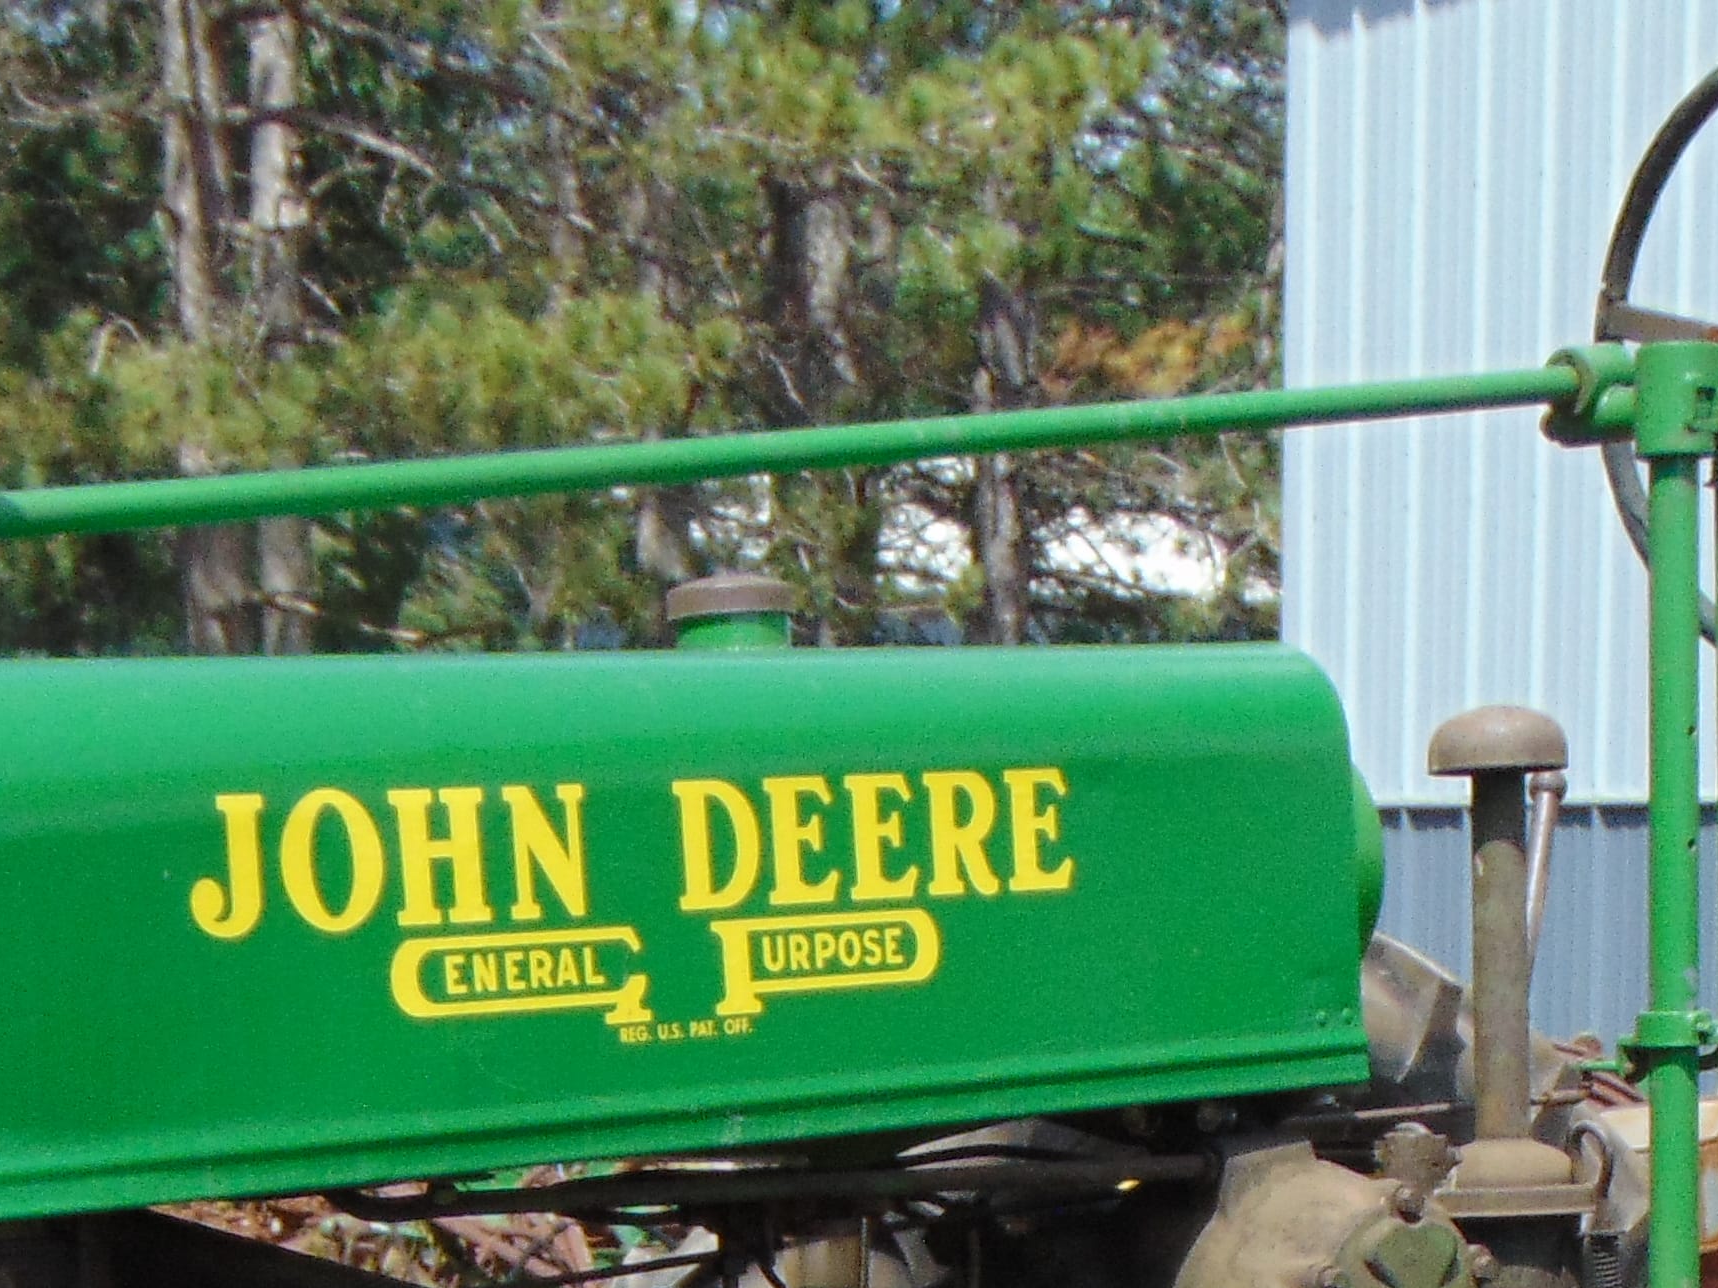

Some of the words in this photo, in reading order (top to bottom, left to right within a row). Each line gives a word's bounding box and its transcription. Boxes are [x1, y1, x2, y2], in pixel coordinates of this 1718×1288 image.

[188, 782, 586, 939] JOHN
[670, 766, 1076, 911] DEERE
[390, 926, 653, 1025] GENERAL
[710, 907, 940, 1017] PURPOSE
